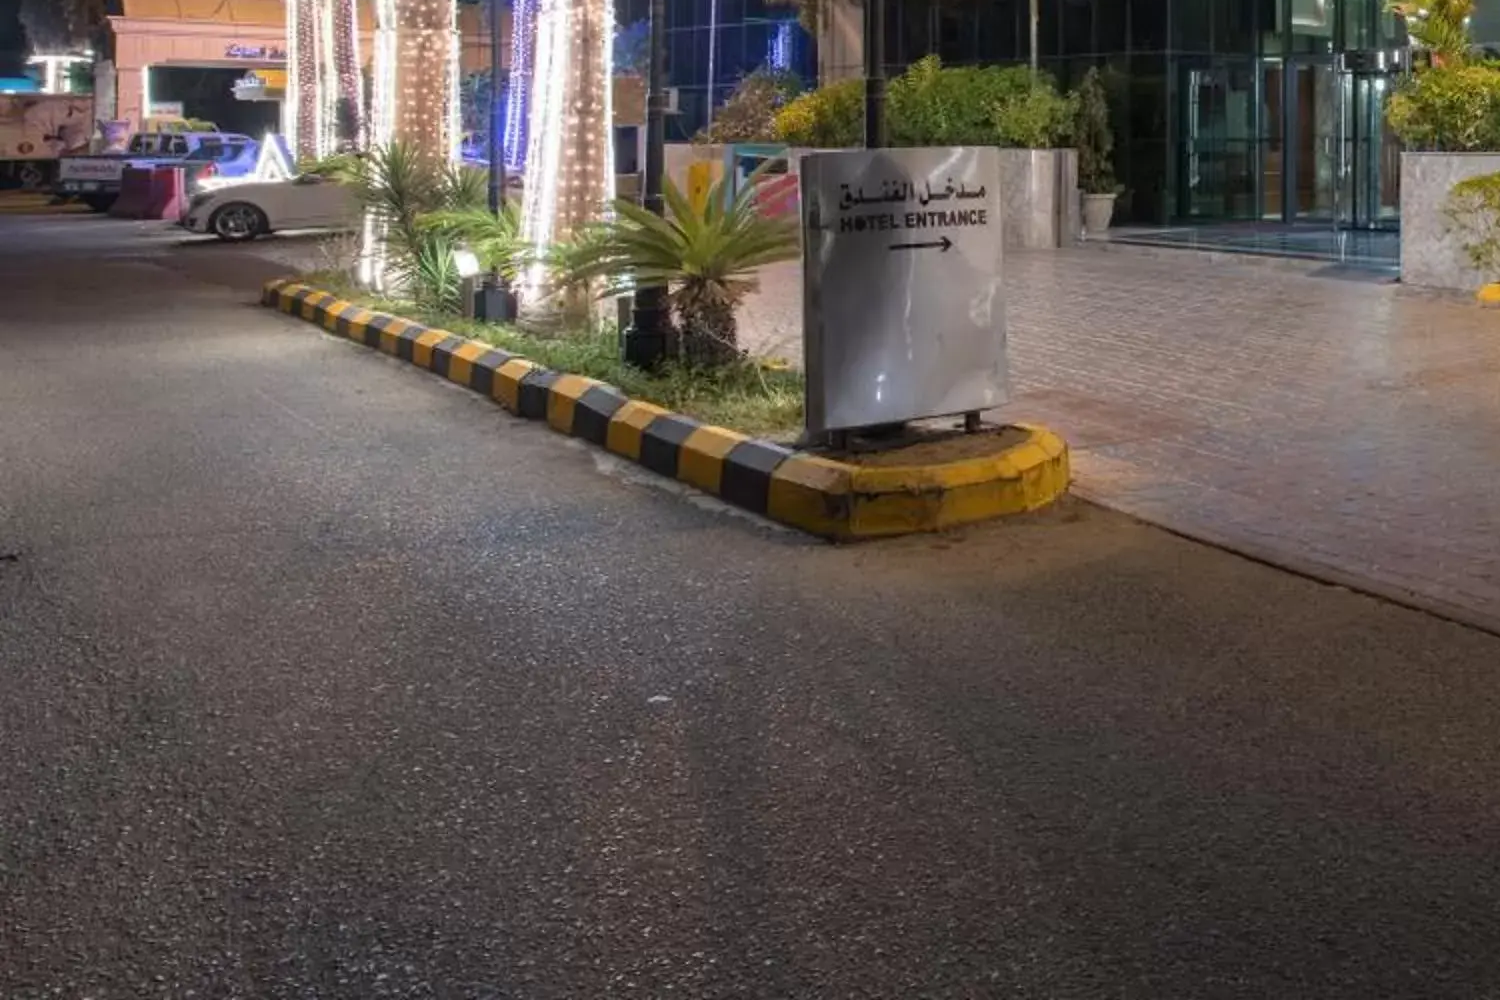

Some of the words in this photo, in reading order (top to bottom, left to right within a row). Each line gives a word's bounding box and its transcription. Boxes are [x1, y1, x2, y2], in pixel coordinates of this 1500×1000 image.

[839, 180, 915, 211] الفندق
[918, 177, 987, 206] مدخل
[840, 213, 900, 233] HOTEL
[905, 209, 987, 227] ENTRANCE
